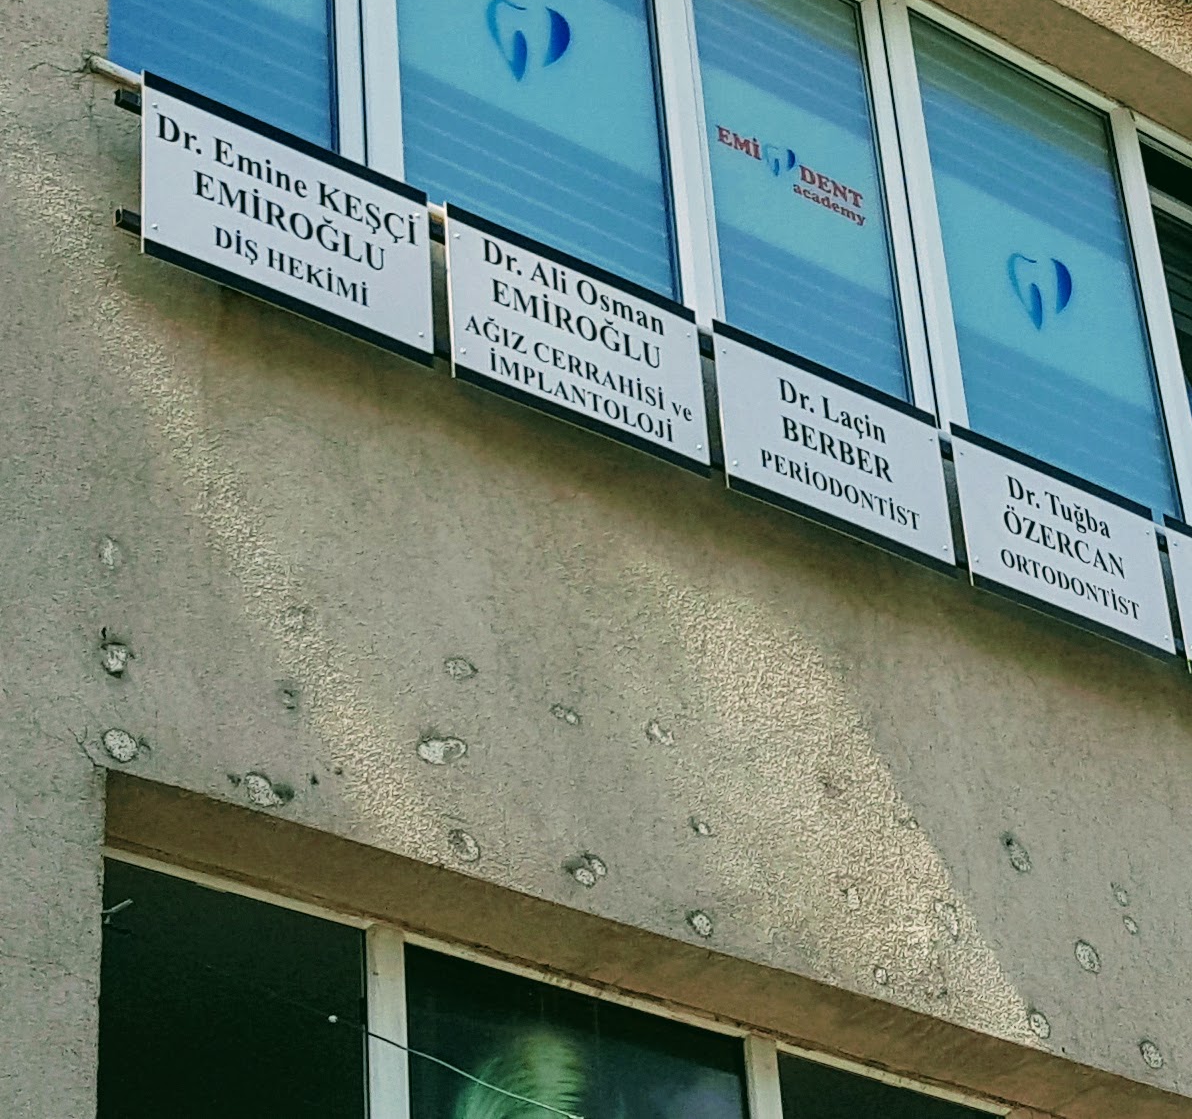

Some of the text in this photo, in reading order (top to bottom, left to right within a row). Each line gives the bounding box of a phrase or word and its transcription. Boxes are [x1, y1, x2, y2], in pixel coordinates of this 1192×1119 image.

[157, 112, 418, 246] Dr. Emine KEŞÇİ
[793, 184, 866, 227] academy
[799, 164, 863, 208] DENT
[194, 170, 385, 271] EMİROĞLU
[213, 225, 370, 307] DİŞ HEKİMİ
[481, 237, 665, 336] Dr. Ali Osman
[491, 278, 660, 369] EMİROĞLU
[465, 316, 693, 422] AĞIZ CERRAHİSİ ve
[490, 347, 676, 443] İMPLANTOLOJİ
[778, 377, 887, 444] Dr. Laçin
[781, 415, 893, 483] BERBER
[760, 448, 920, 531] PERİODONTİST
[1006, 475, 1111, 539] Dr. Tuğba
[1004, 505, 1125, 580] ÖZERCAN
[1001, 548, 1140, 620] ORTODONTİST
